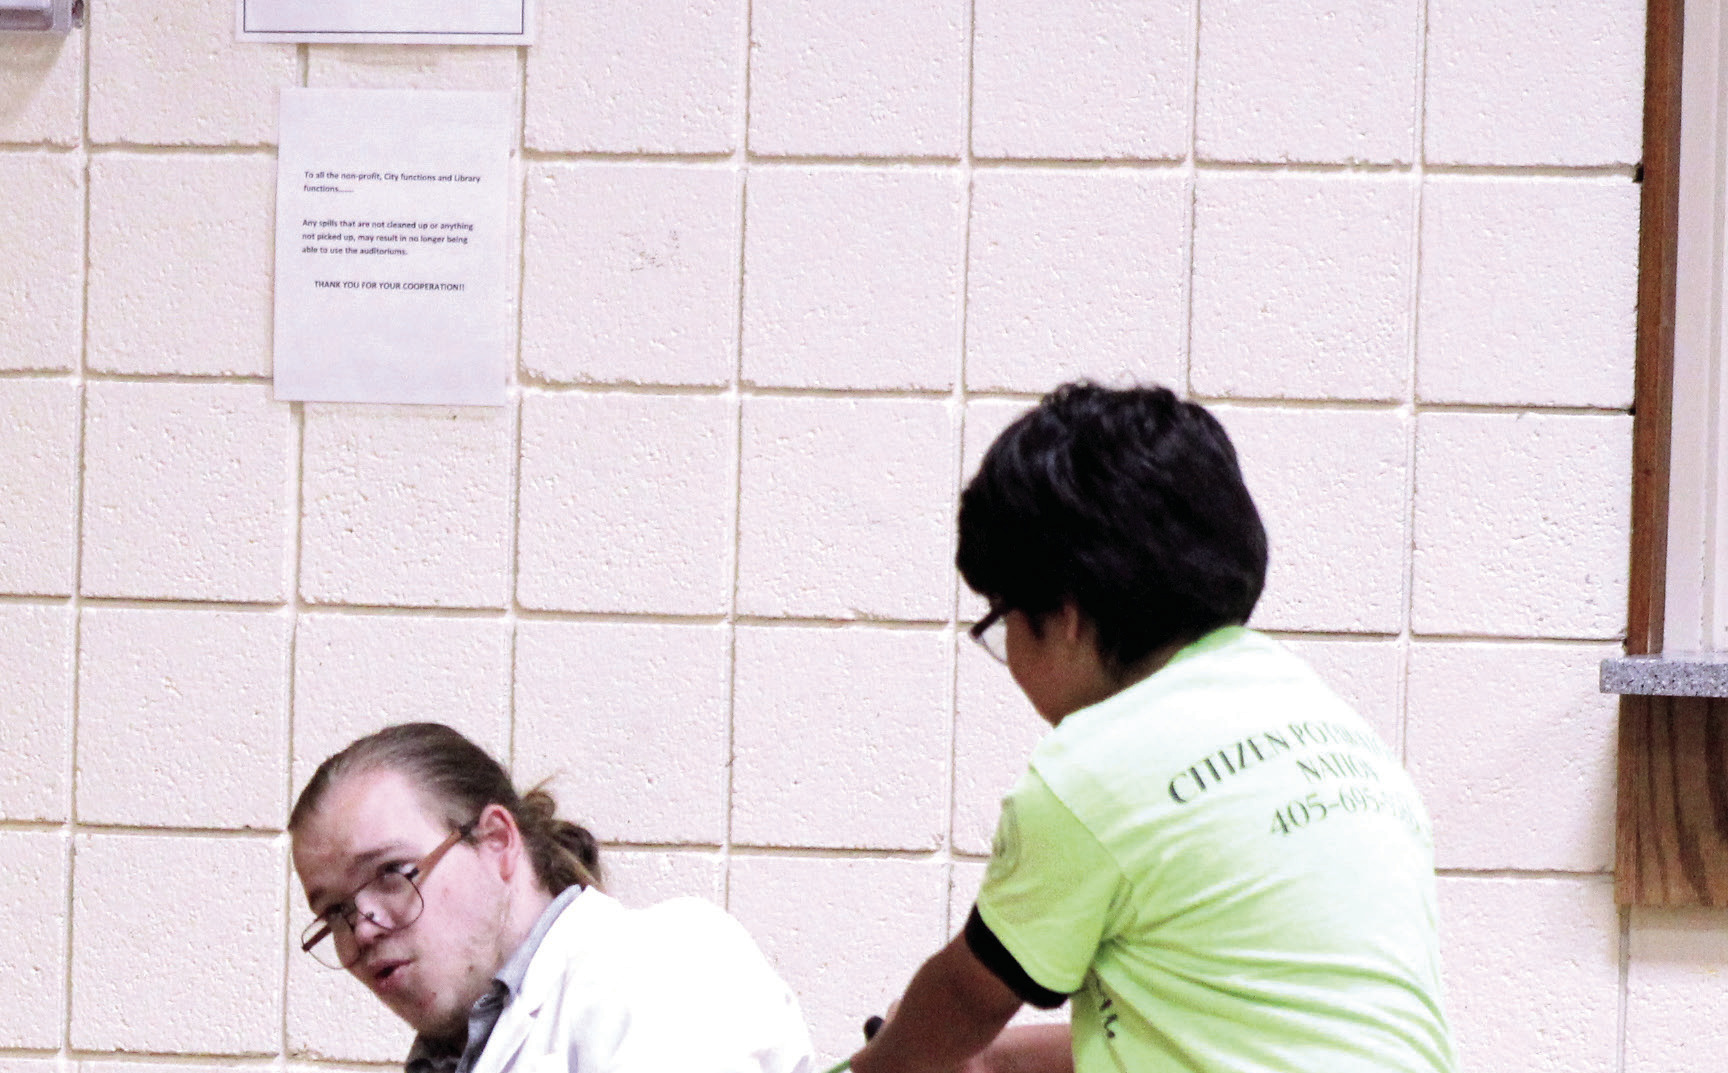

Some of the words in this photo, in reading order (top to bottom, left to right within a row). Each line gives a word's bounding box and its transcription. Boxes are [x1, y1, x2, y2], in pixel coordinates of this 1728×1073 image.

[340, 172, 382, 181] non-profit,
[384, 173, 399, 182] City
[400, 173, 436, 181] functions
[438, 174, 452, 182] and
[454, 174, 481, 183] Library
[302, 220, 317, 228] Any
[319, 220, 338, 228] spills
[440, 222, 474, 231] anything
[317, 233, 342, 242] picked
[376, 234, 398, 242] result
[420, 236, 444, 244] longer
[447, 236, 468, 245] being
[314, 280, 340, 288] THANK
[379, 282, 401, 290] YOUR
[1167, 731, 1290, 805] CITIZEN
